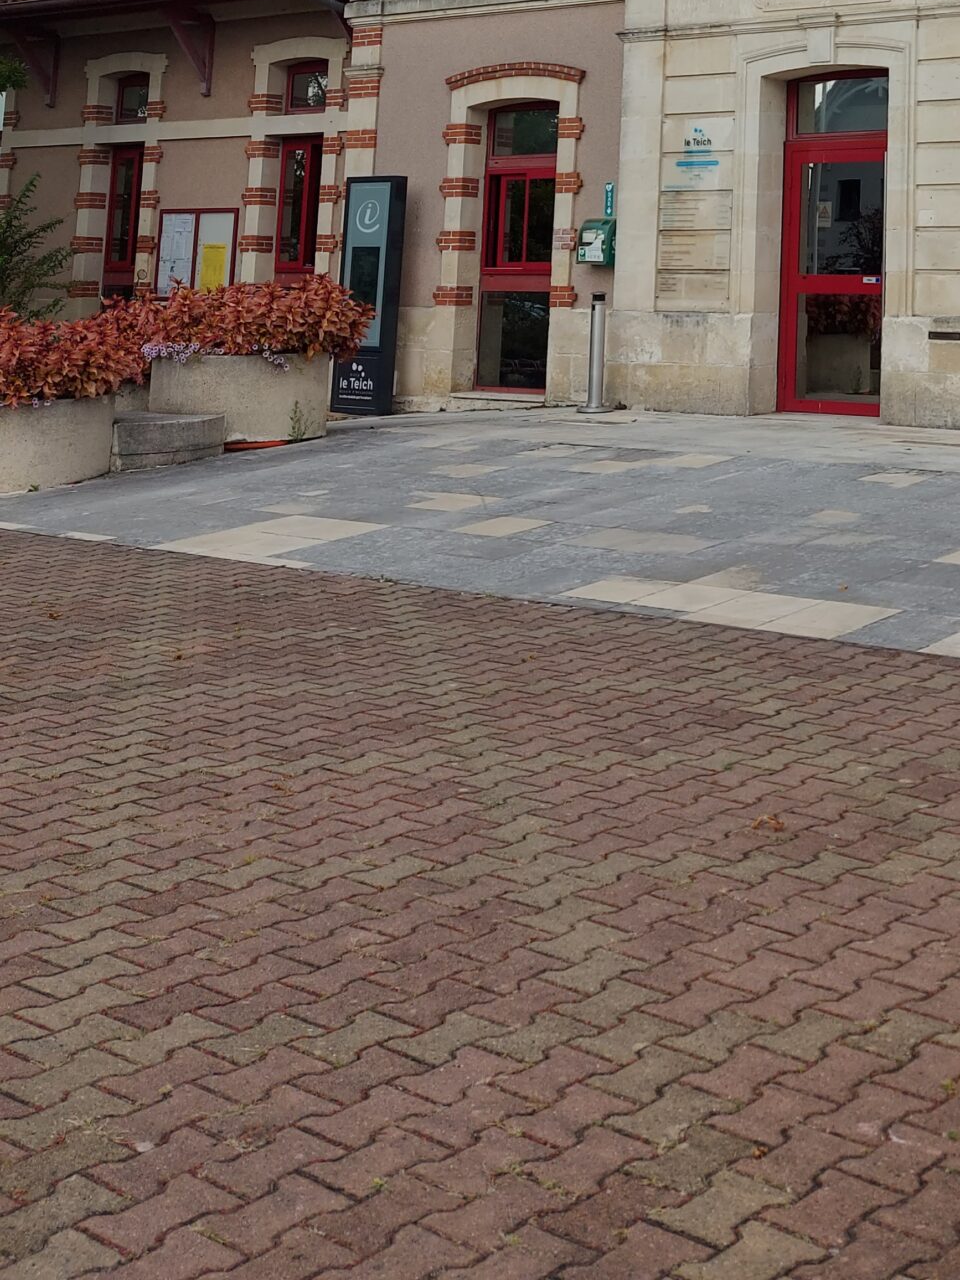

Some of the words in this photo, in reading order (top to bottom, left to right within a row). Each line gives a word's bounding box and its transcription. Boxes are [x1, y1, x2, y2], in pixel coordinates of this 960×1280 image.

[684, 138, 691, 147] le
[692, 137, 712, 147] Teich
[339, 376, 348, 389] le
[349, 377, 373, 390] Teich
